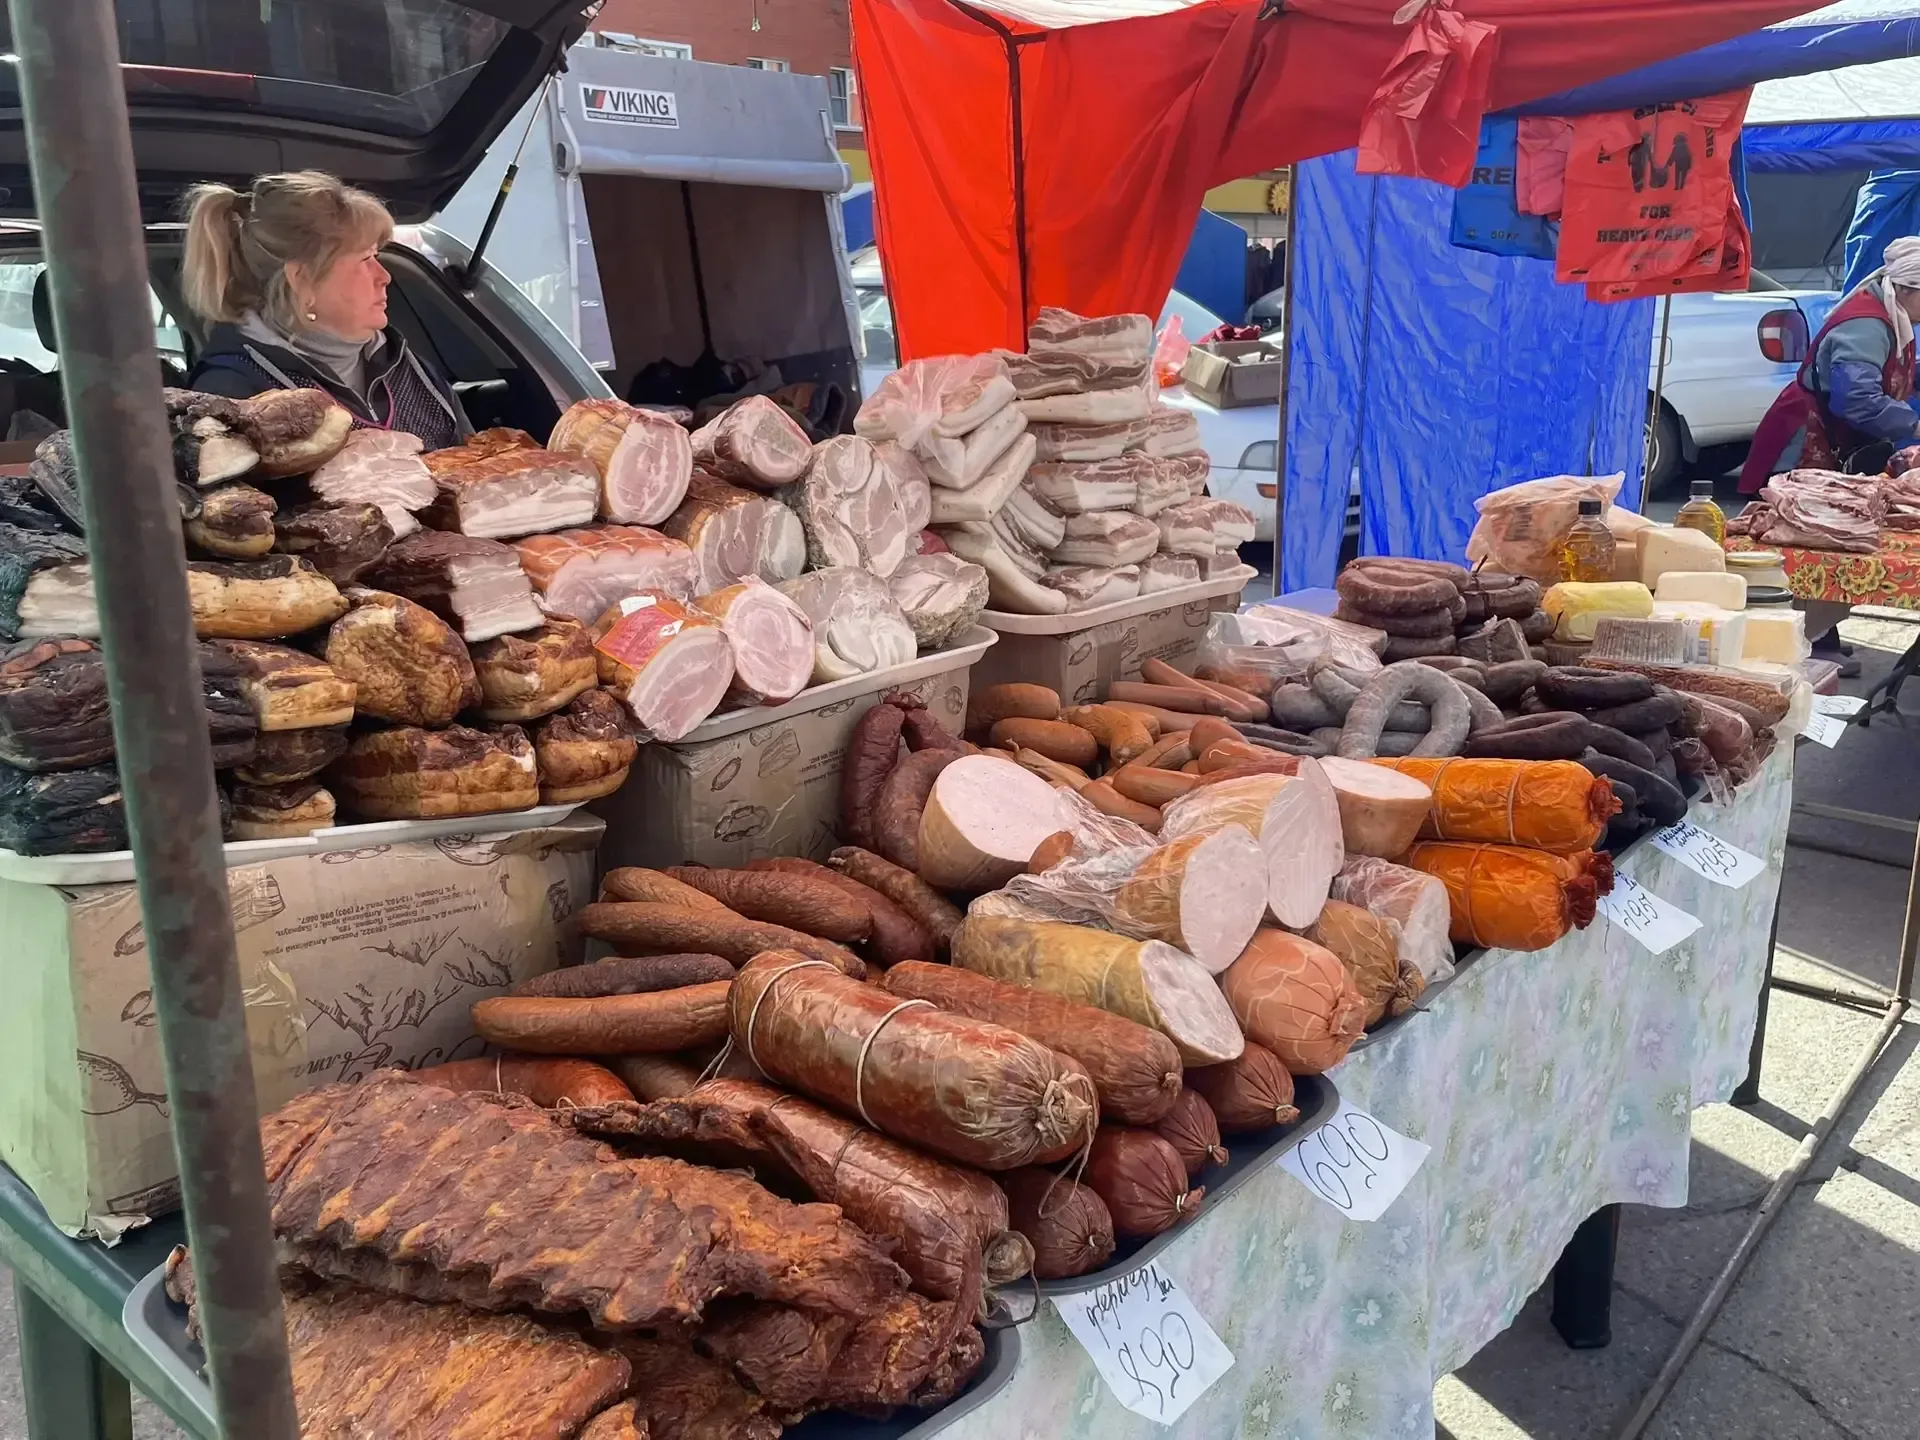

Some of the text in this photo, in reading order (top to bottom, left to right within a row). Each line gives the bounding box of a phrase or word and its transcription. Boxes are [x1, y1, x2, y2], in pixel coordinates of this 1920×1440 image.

[608, 90, 670, 116] VIKING
[1639, 205, 1671, 219] FOR
[1596, 229, 1649, 242] HEAVY
[1688, 841, 1737, 878] 495
[1297, 1111, 1389, 1210] 690
